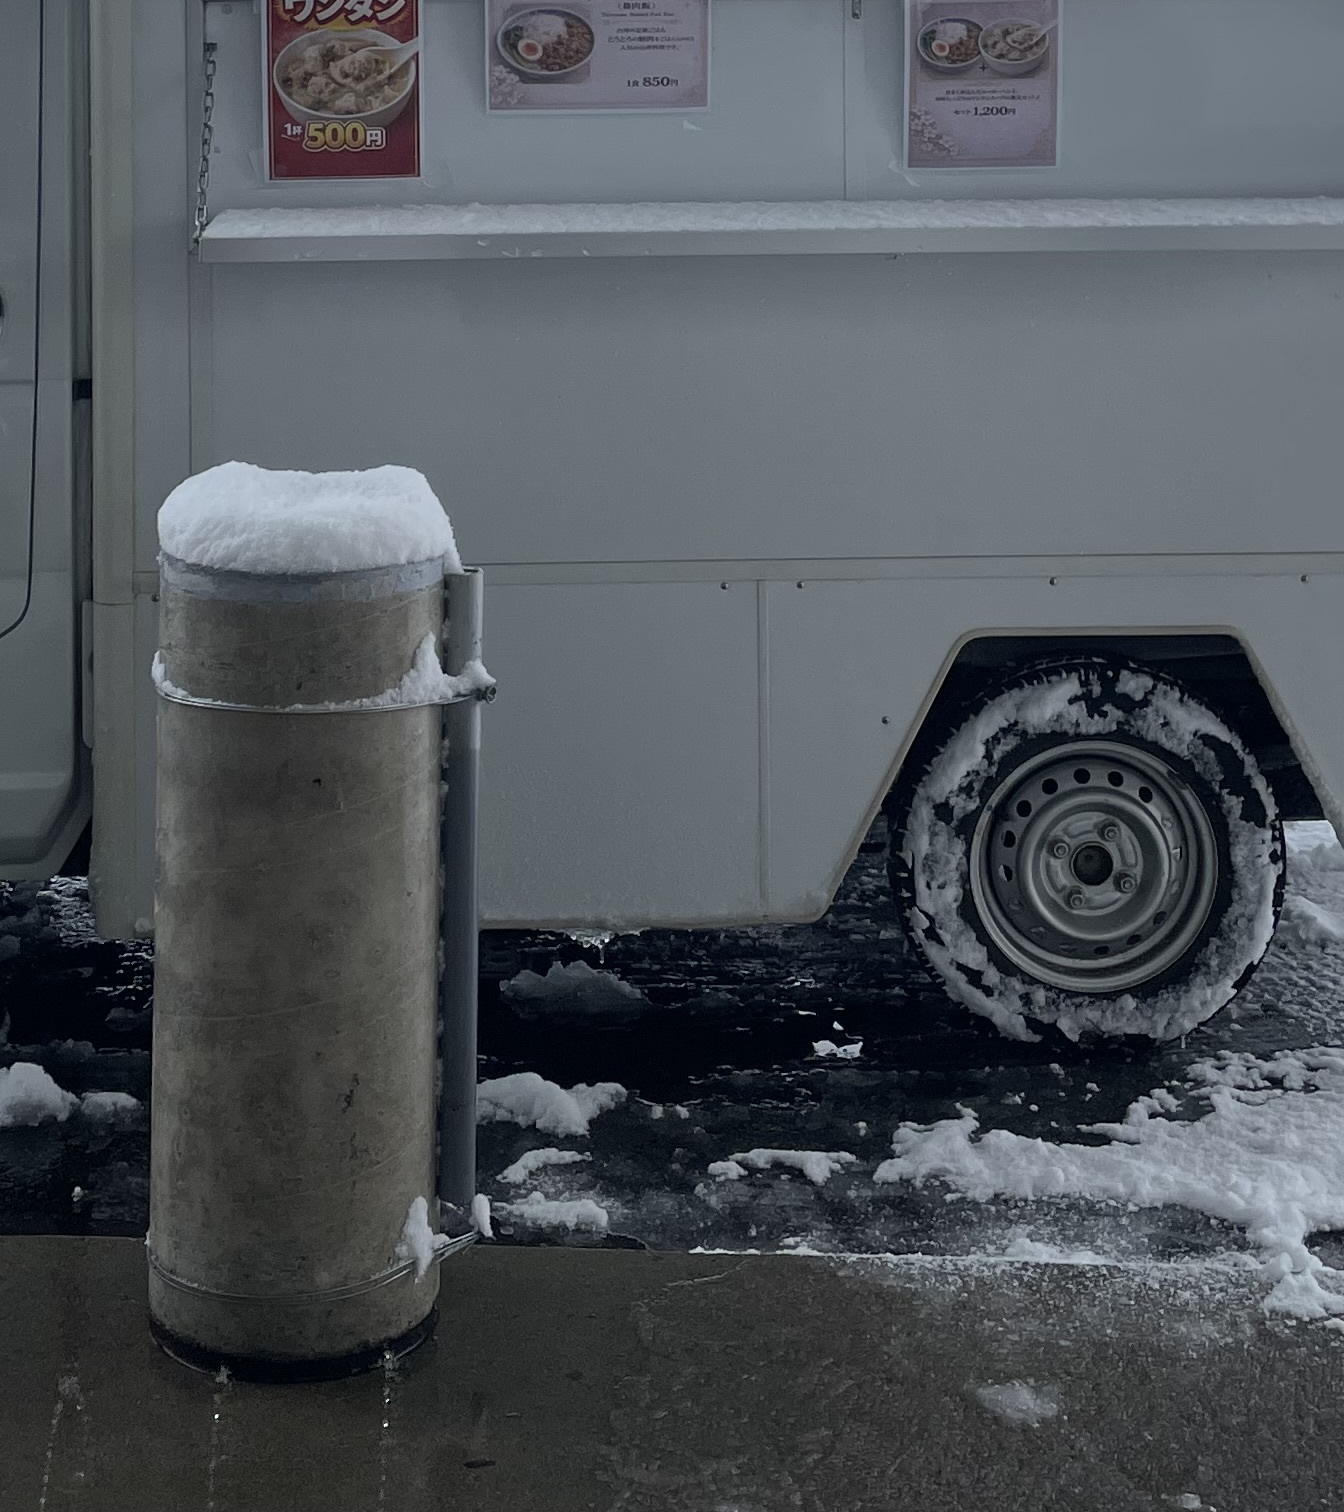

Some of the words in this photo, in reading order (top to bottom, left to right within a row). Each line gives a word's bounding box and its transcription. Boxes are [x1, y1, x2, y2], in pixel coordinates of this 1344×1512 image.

[643, 76, 679, 87] 850円
[973, 106, 1016, 117] 1,200円
[304, 121, 385, 150] 500円
